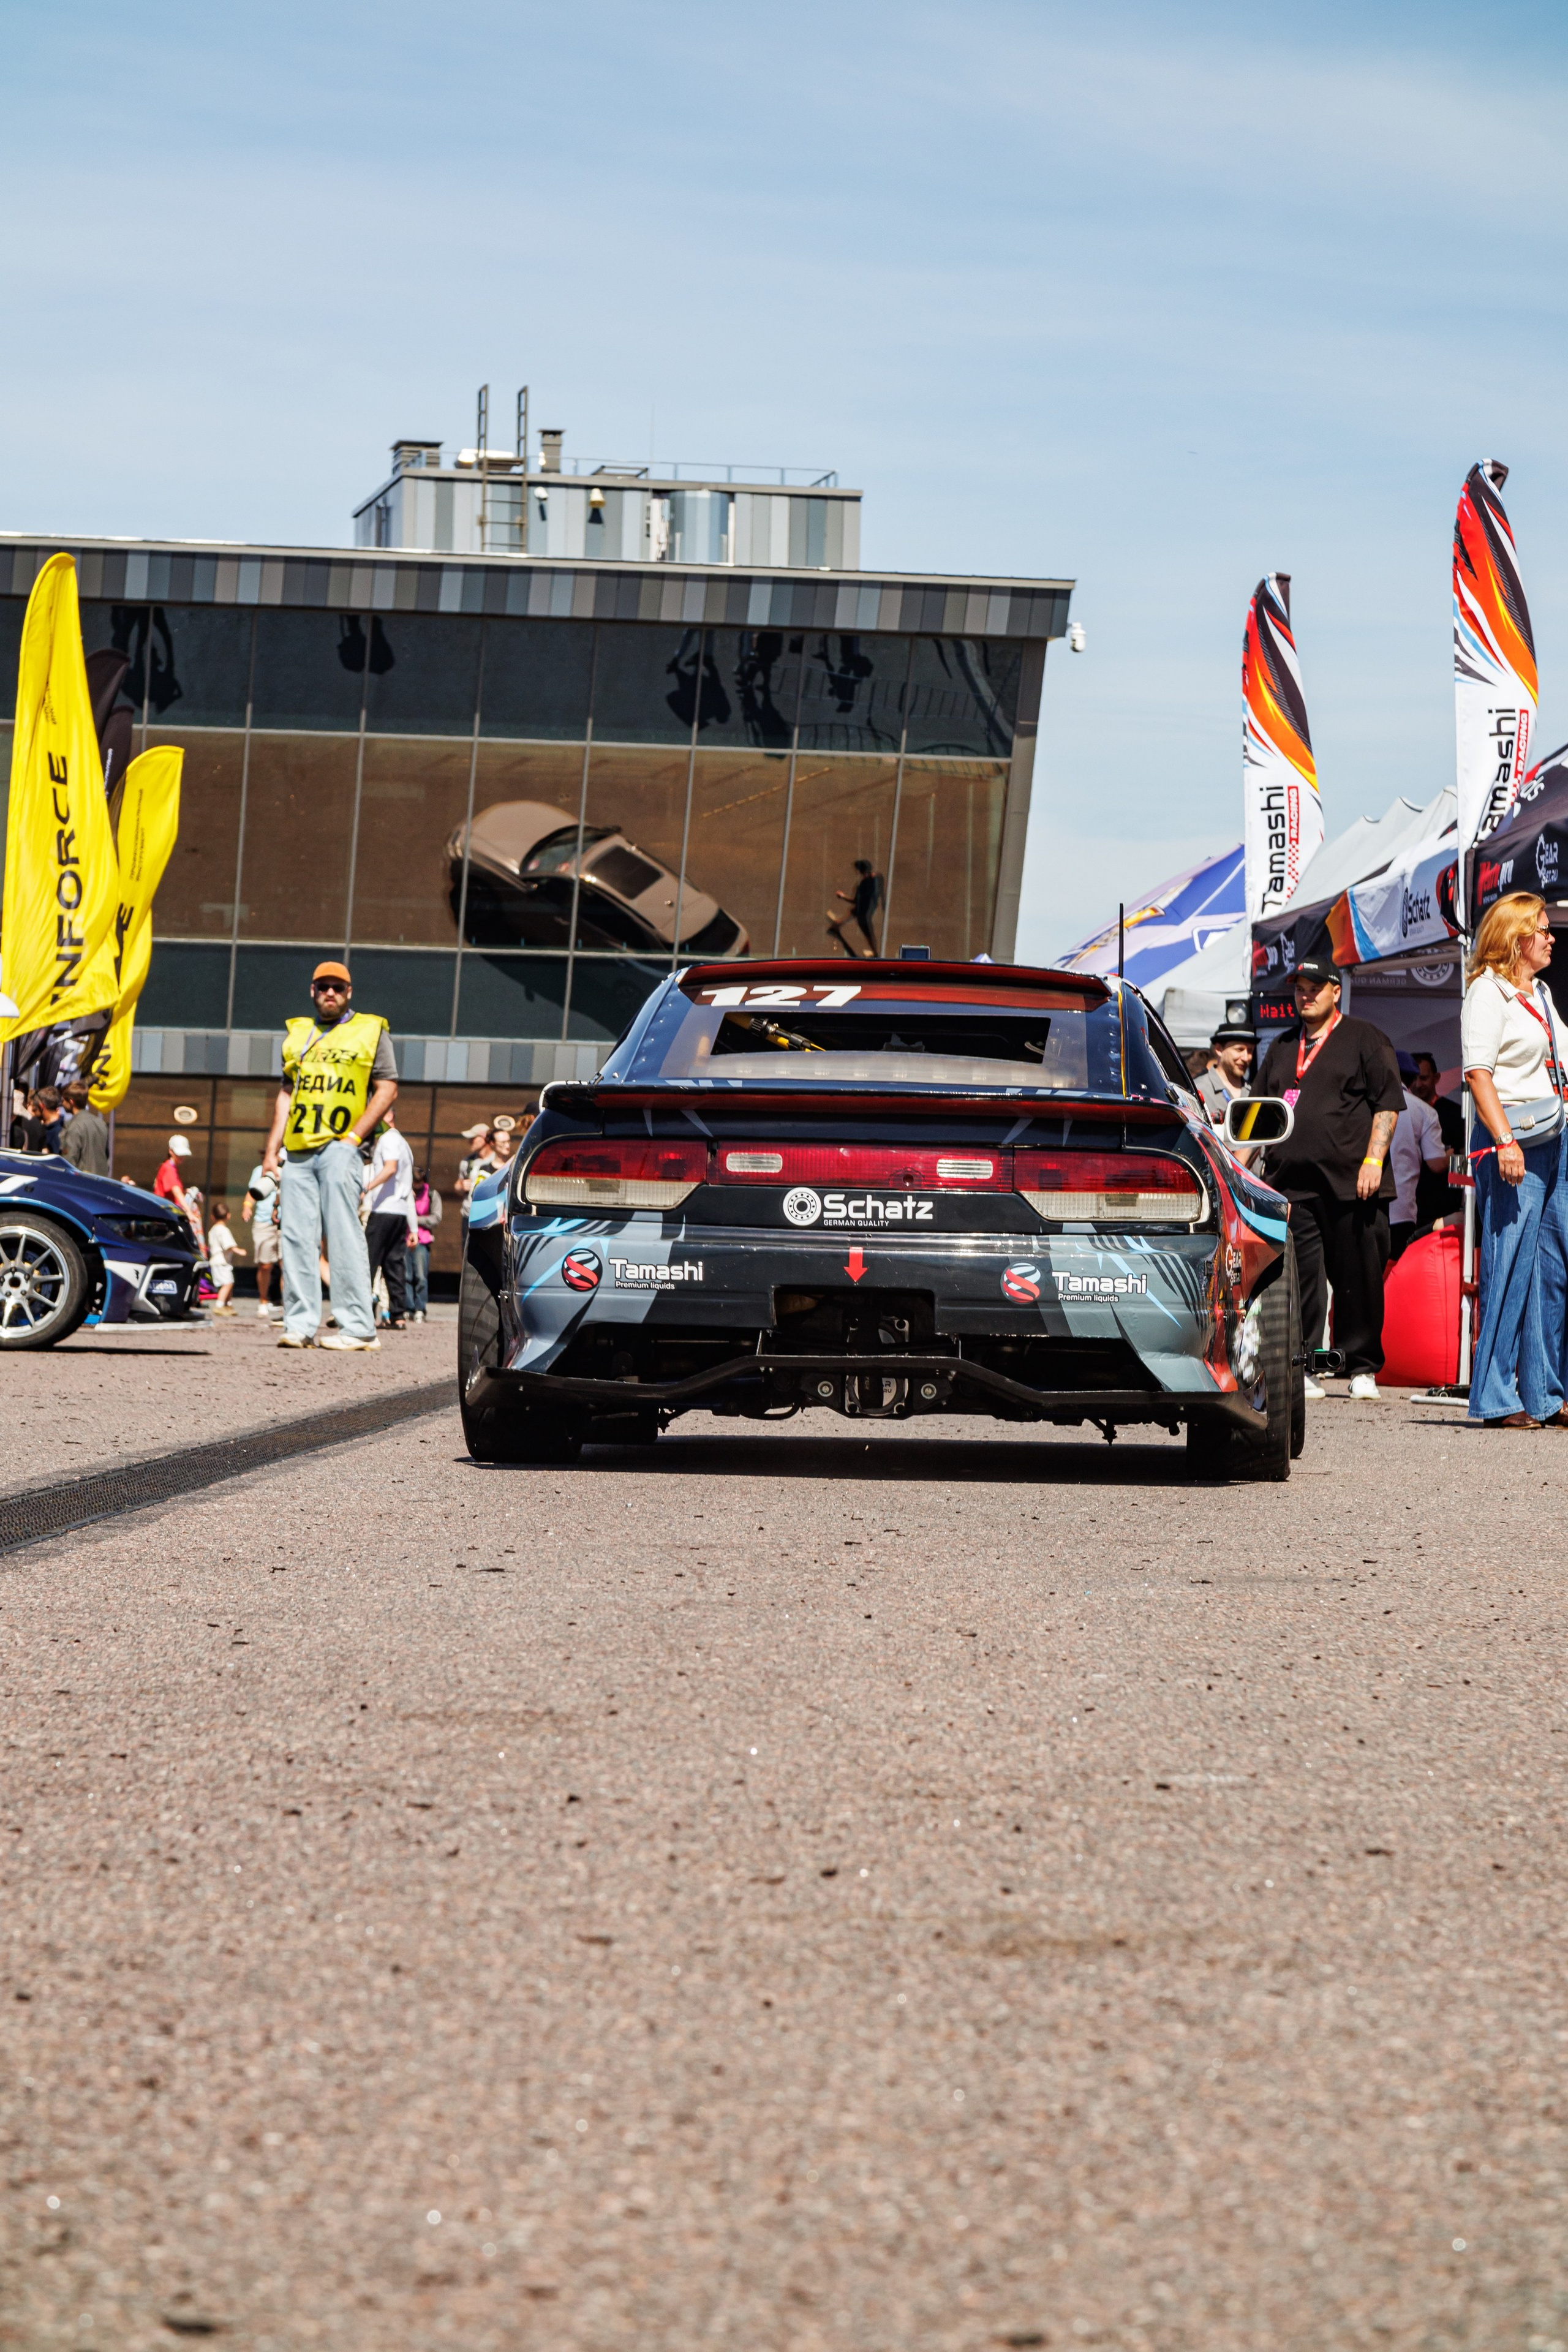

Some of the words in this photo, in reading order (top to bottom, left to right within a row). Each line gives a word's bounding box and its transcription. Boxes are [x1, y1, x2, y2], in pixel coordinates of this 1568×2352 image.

[1517, 712, 1528, 773] RACING
[1289, 788, 1298, 839] RACING
[1259, 786, 1286, 915] Tamashi
[702, 985, 862, 1007] 127
[1259, 1003, 1295, 1019] Wait
[292, 1103, 352, 1136] 210
[823, 1194, 934, 1219] Schatz
[609, 1258, 704, 1281] Tamashi
[650, 1281, 675, 1291] liquids
[1052, 1271, 1147, 1294] Tamashi
[1058, 1293, 1092, 1302] Premium
[1093, 1294, 1119, 1303] liquids
